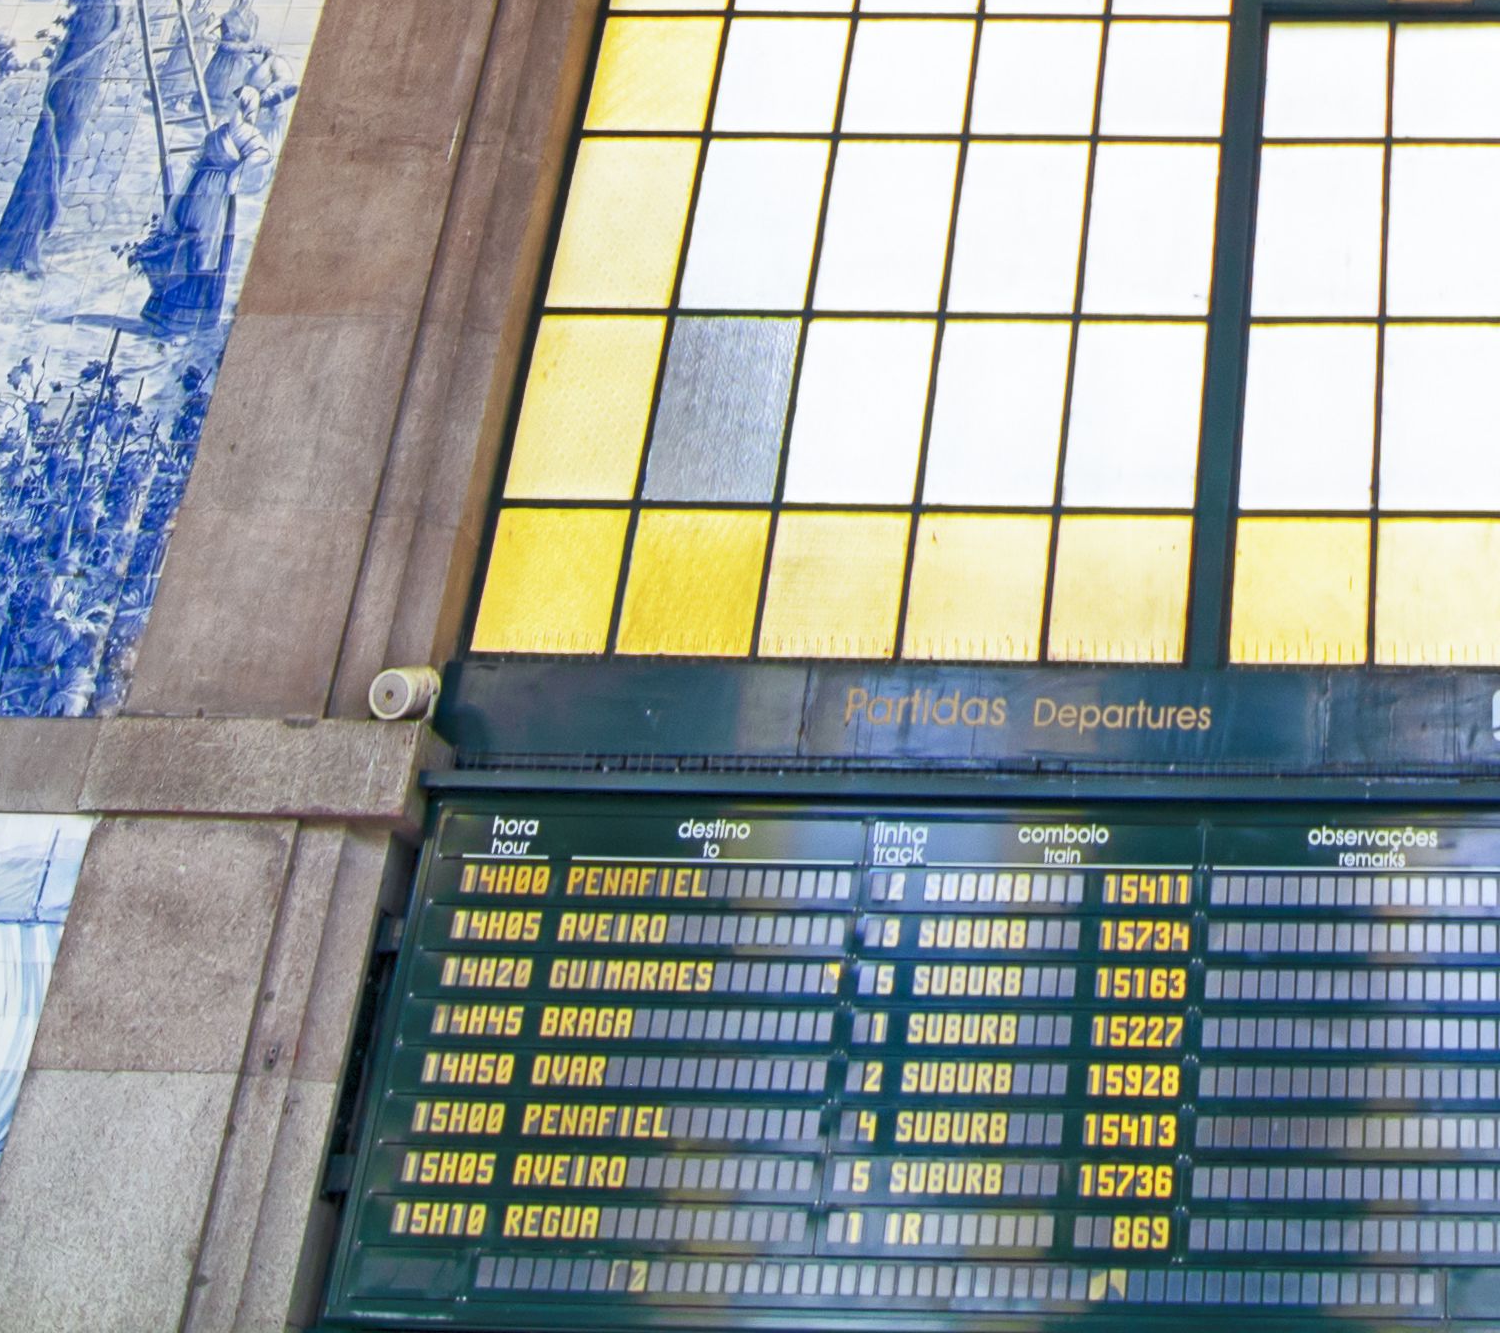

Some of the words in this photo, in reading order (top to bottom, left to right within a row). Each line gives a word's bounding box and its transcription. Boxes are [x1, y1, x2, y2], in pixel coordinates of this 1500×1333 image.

[844, 687, 1007, 726] Partidas
[1033, 698, 1211, 735] Departures
[491, 838, 530, 855] hour
[703, 842, 720, 858] to
[873, 844, 924, 864] track
[1044, 846, 1081, 864] train
[1338, 851, 1406, 868] remarks
[493, 815, 539, 835] hora
[678, 819, 750, 839] destino
[873, 822, 929, 844] linha
[1018, 823, 1110, 844] comboio
[1308, 827, 1438, 851] observações
[462, 865, 549, 894] 14H00
[566, 866, 707, 896] PENAFIEL
[888, 872, 906, 901] 2
[924, 873, 1031, 902] SUBURB
[1104, 875, 1192, 904] 15411
[453, 910, 542, 940] 14H05
[557, 913, 667, 942] AVEIRO
[882, 919, 900, 948] 3
[918, 919, 1026, 949] SUBURB
[1101, 920, 1190, 951] 15734
[443, 957, 533, 988] 14H20
[549, 960, 714, 991] GUIMARAES
[876, 965, 895, 994] 5
[913, 965, 1022, 996] SUBURB
[1097, 968, 1186, 1000] 15163
[434, 1005, 524, 1035] 14H45
[539, 1007, 634, 1038] BRAGA
[872, 1014, 886, 1043] 1
[907, 1014, 1017, 1044] SUBURB
[1093, 1015, 1184, 1047] 15227
[424, 1053, 515, 1084] 14H50
[531, 1055, 607, 1085] OVAR
[864, 1061, 883, 1092] 2
[901, 1062, 1012, 1094] SUBURB
[1088, 1064, 1180, 1096] 15928
[414, 1102, 506, 1133] 15H00
[521, 1104, 669, 1137] PENAFIEL
[859, 1110, 877, 1142] 4
[895, 1111, 1008, 1144] SUBURB
[1085, 1114, 1177, 1147] 15413
[405, 1152, 497, 1184] 15H05
[512, 1154, 627, 1187] AVEIRO
[852, 1160, 870, 1193] 5
[889, 1161, 1002, 1195] SUBURB
[1080, 1164, 1173, 1197] 15736
[394, 1203, 487, 1235] 15H10
[503, 1205, 599, 1238] REGUA
[848, 1213, 862, 1244] 1
[886, 1213, 921, 1245] IR
[1112, 1216, 1170, 1248] 869
